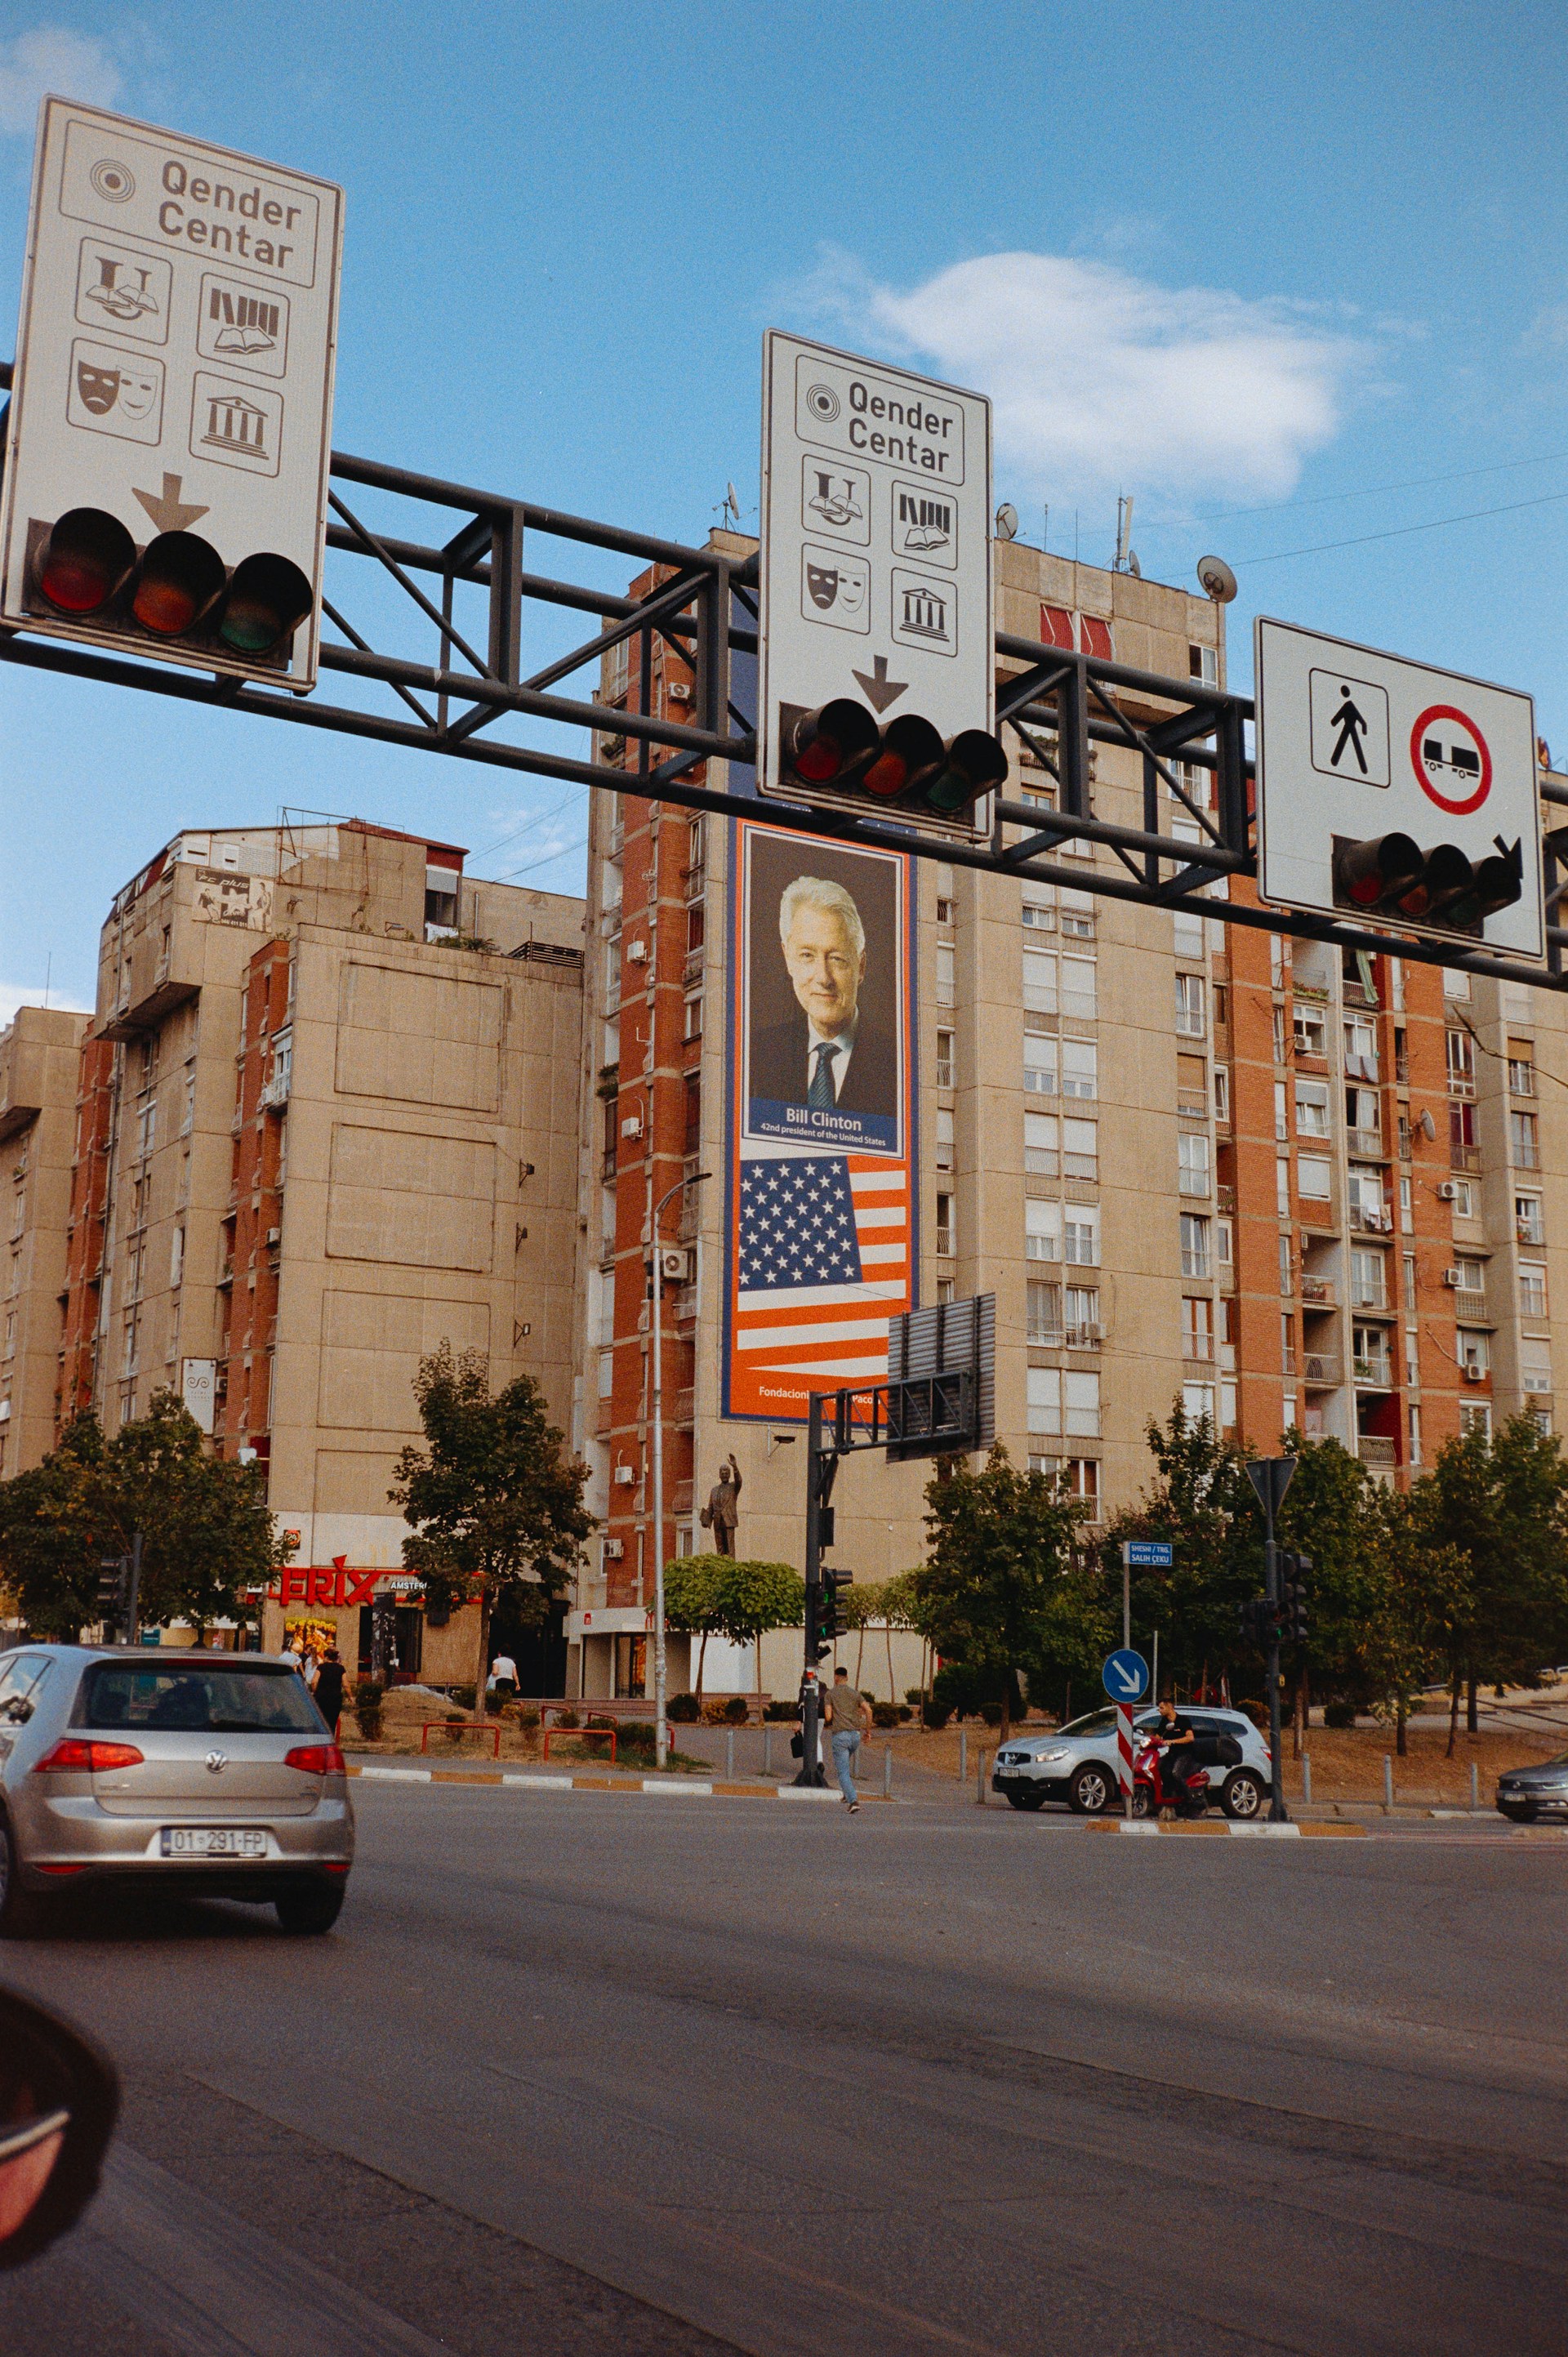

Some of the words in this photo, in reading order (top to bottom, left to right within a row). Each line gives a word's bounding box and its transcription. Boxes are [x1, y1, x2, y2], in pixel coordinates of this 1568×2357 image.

[162, 160, 302, 230] Qender
[158, 200, 294, 269] Centar
[849, 381, 953, 439] Qender
[849, 417, 950, 473] Centar
[219, 880, 250, 889] plus
[786, 1107, 808, 1124] Bill
[811, 1112, 862, 1131] Clinton
[760, 1122, 780, 1132] 42nd
[781, 1126, 816, 1137] president
[817, 1129, 825, 1138] of
[826, 1129, 838, 1139] the
[839, 1132, 863, 1143] United
[864, 1136, 886, 1146] States
[759, 1385, 810, 1400] Fondacioni
[1131, 1553, 1151, 1562] SALIH
[1152, 1554, 1169, 1564] ÇEKU
